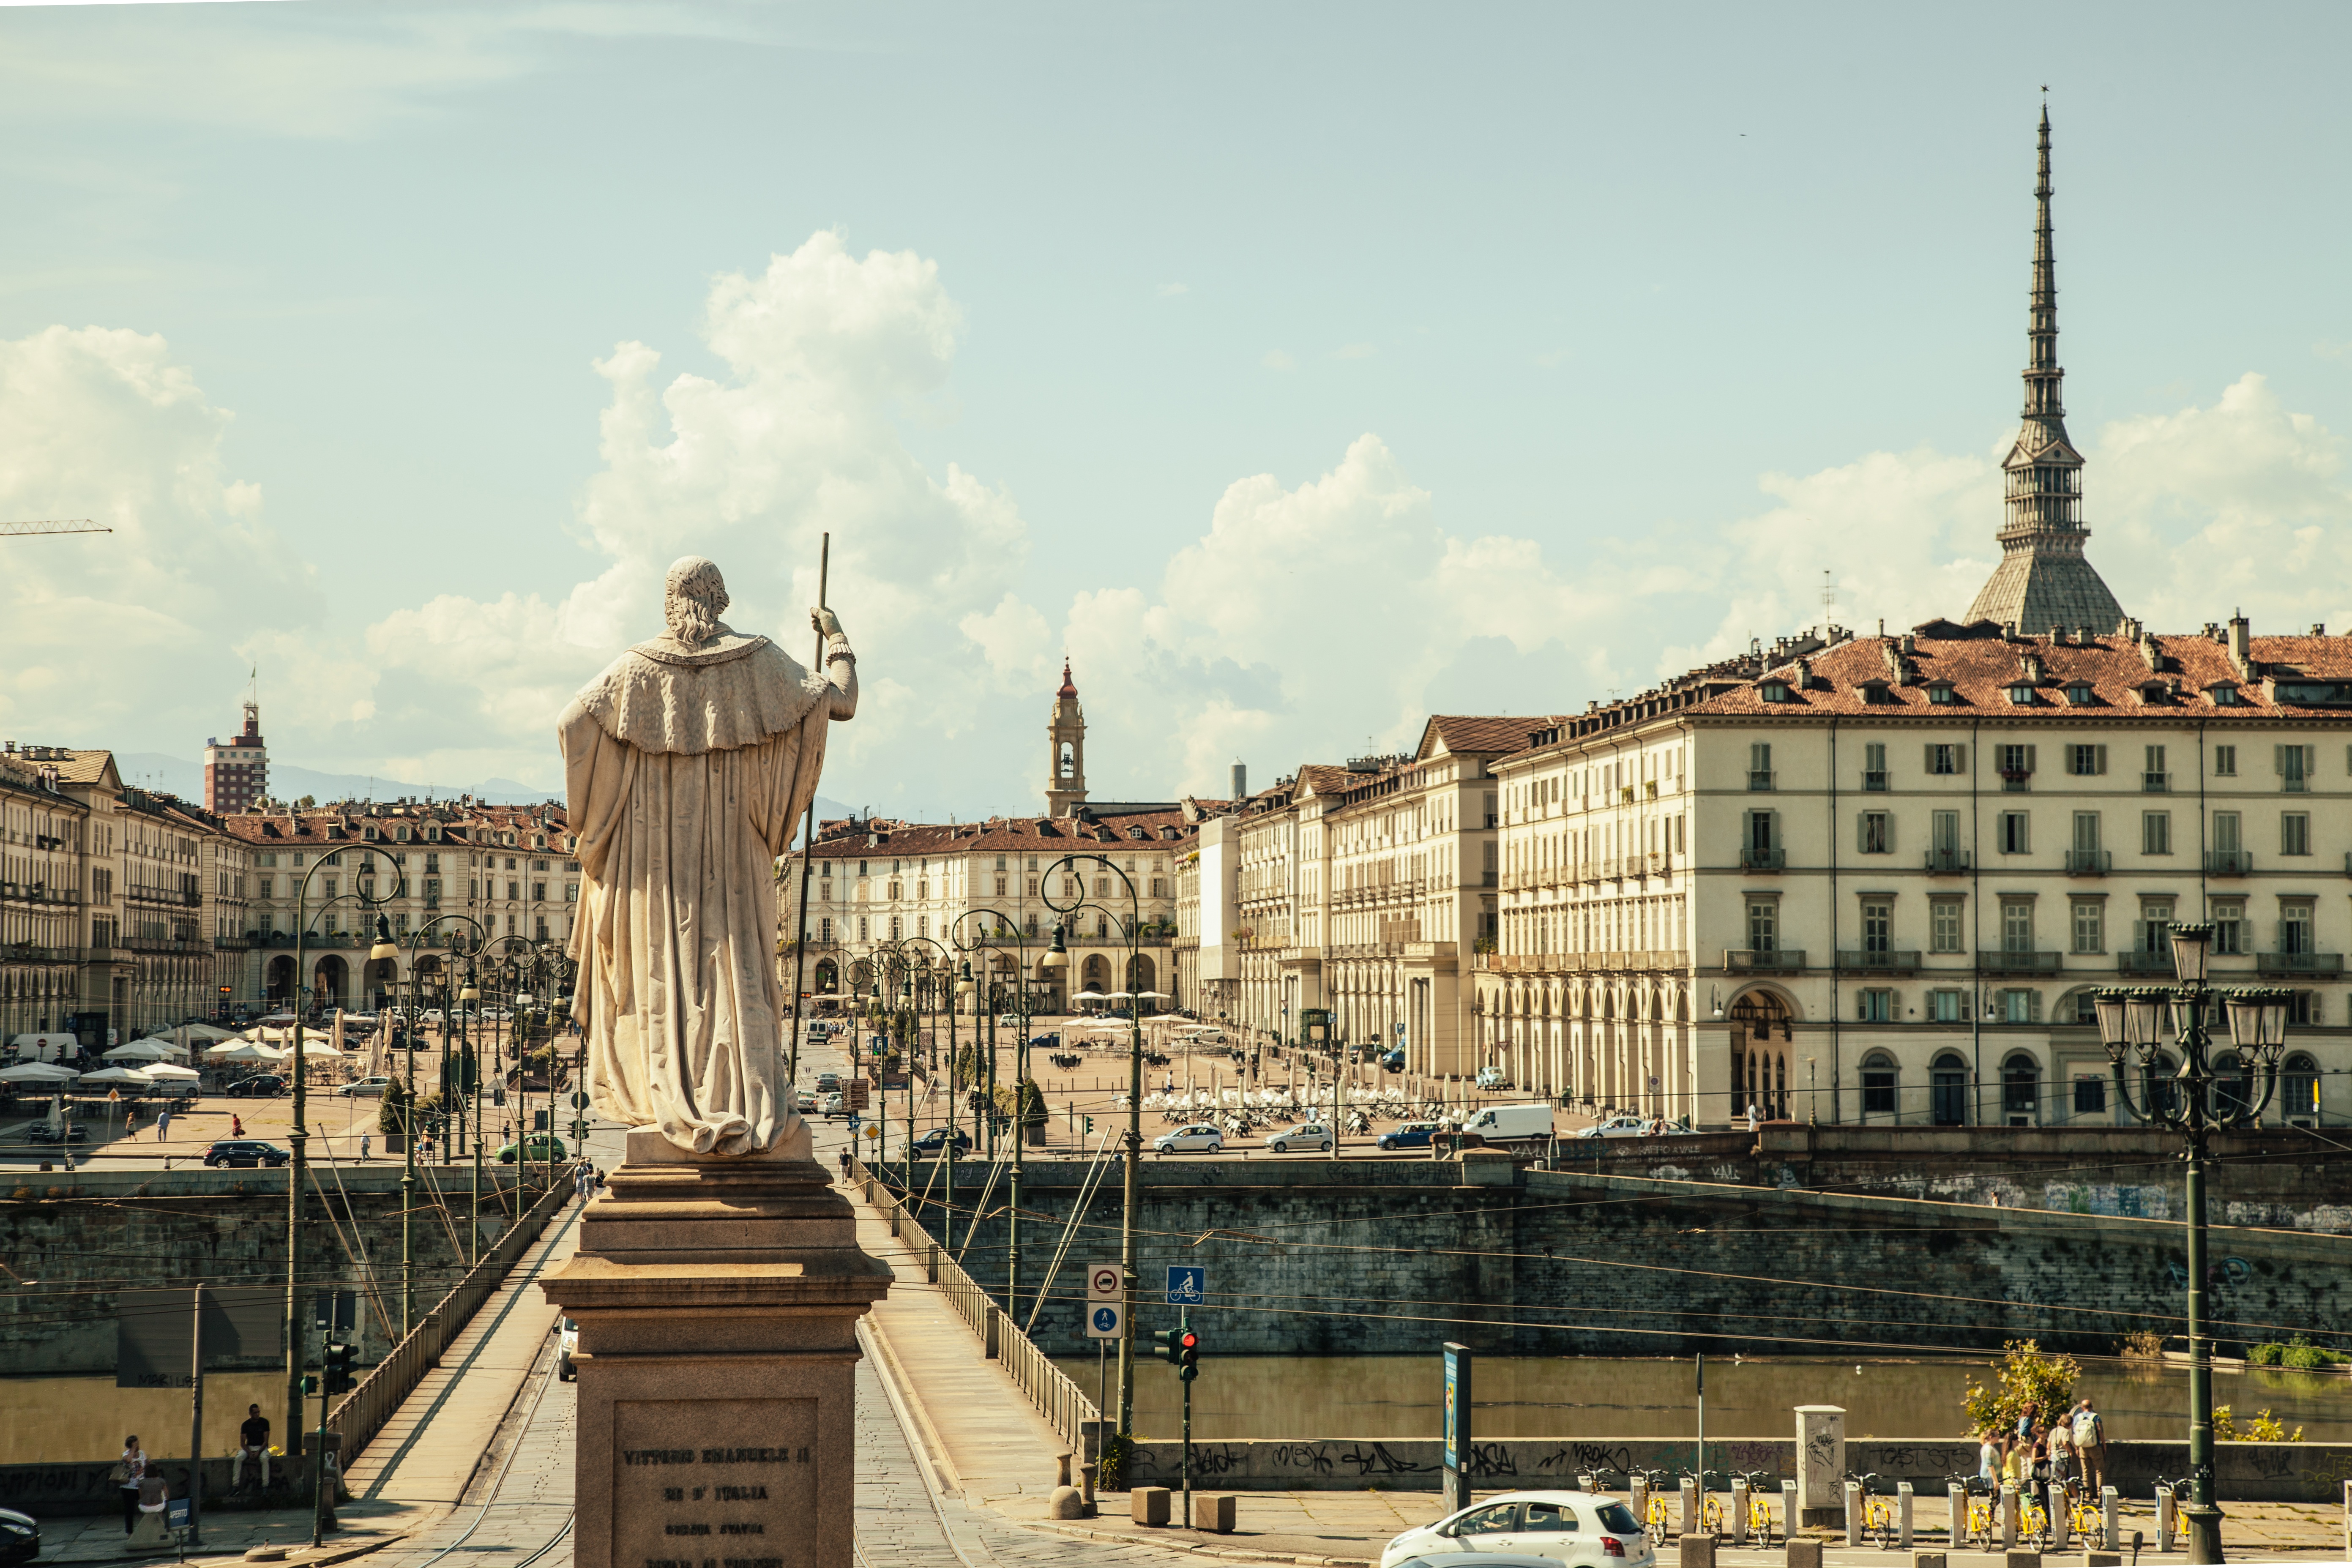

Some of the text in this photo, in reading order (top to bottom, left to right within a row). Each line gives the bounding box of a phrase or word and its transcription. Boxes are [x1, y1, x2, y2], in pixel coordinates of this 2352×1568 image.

[623, 1448, 809, 1465] VITTORIO EMANUELE II
[664, 1487, 683, 1501] RE
[715, 1486, 768, 1501] ITALIA
[169, 1508, 188, 1519] APERTO
[719, 1523, 764, 1535] STATUA
